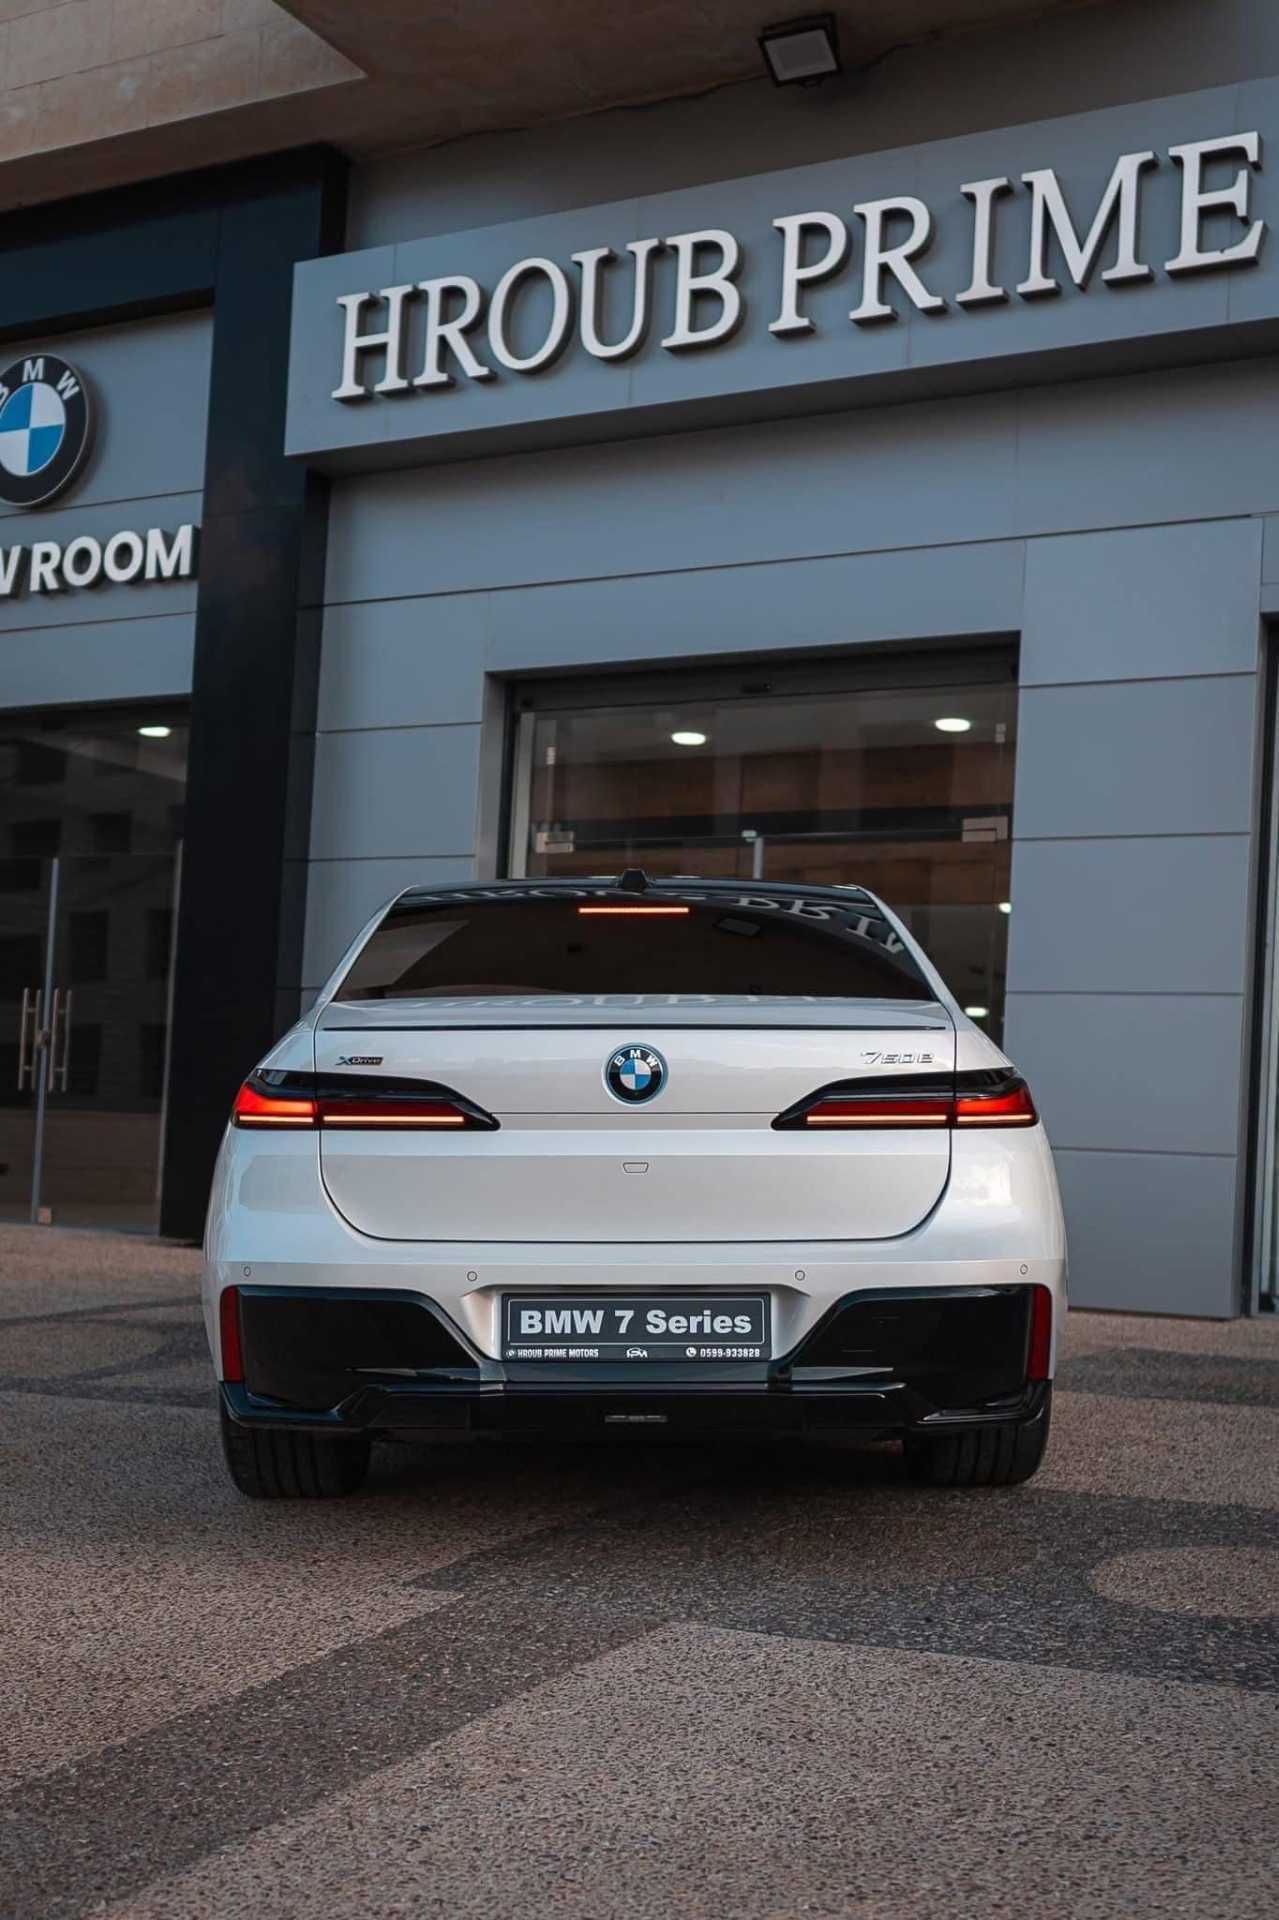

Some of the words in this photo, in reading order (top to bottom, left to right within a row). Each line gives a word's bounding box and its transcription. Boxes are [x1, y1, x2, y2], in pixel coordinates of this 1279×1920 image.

[331, 229, 742, 400] HROUB
[767, 130, 1266, 334] PRIME
[614, 1049, 658, 1067] BMW
[520, 1309, 605, 1335] BMW
[614, 1310, 635, 1334] 7
[645, 1309, 752, 1335] Series
[517, 1348, 543, 1359] HROUB
[543, 1348, 568, 1359] PRIME
[568, 1348, 600, 1359] MOTORS
